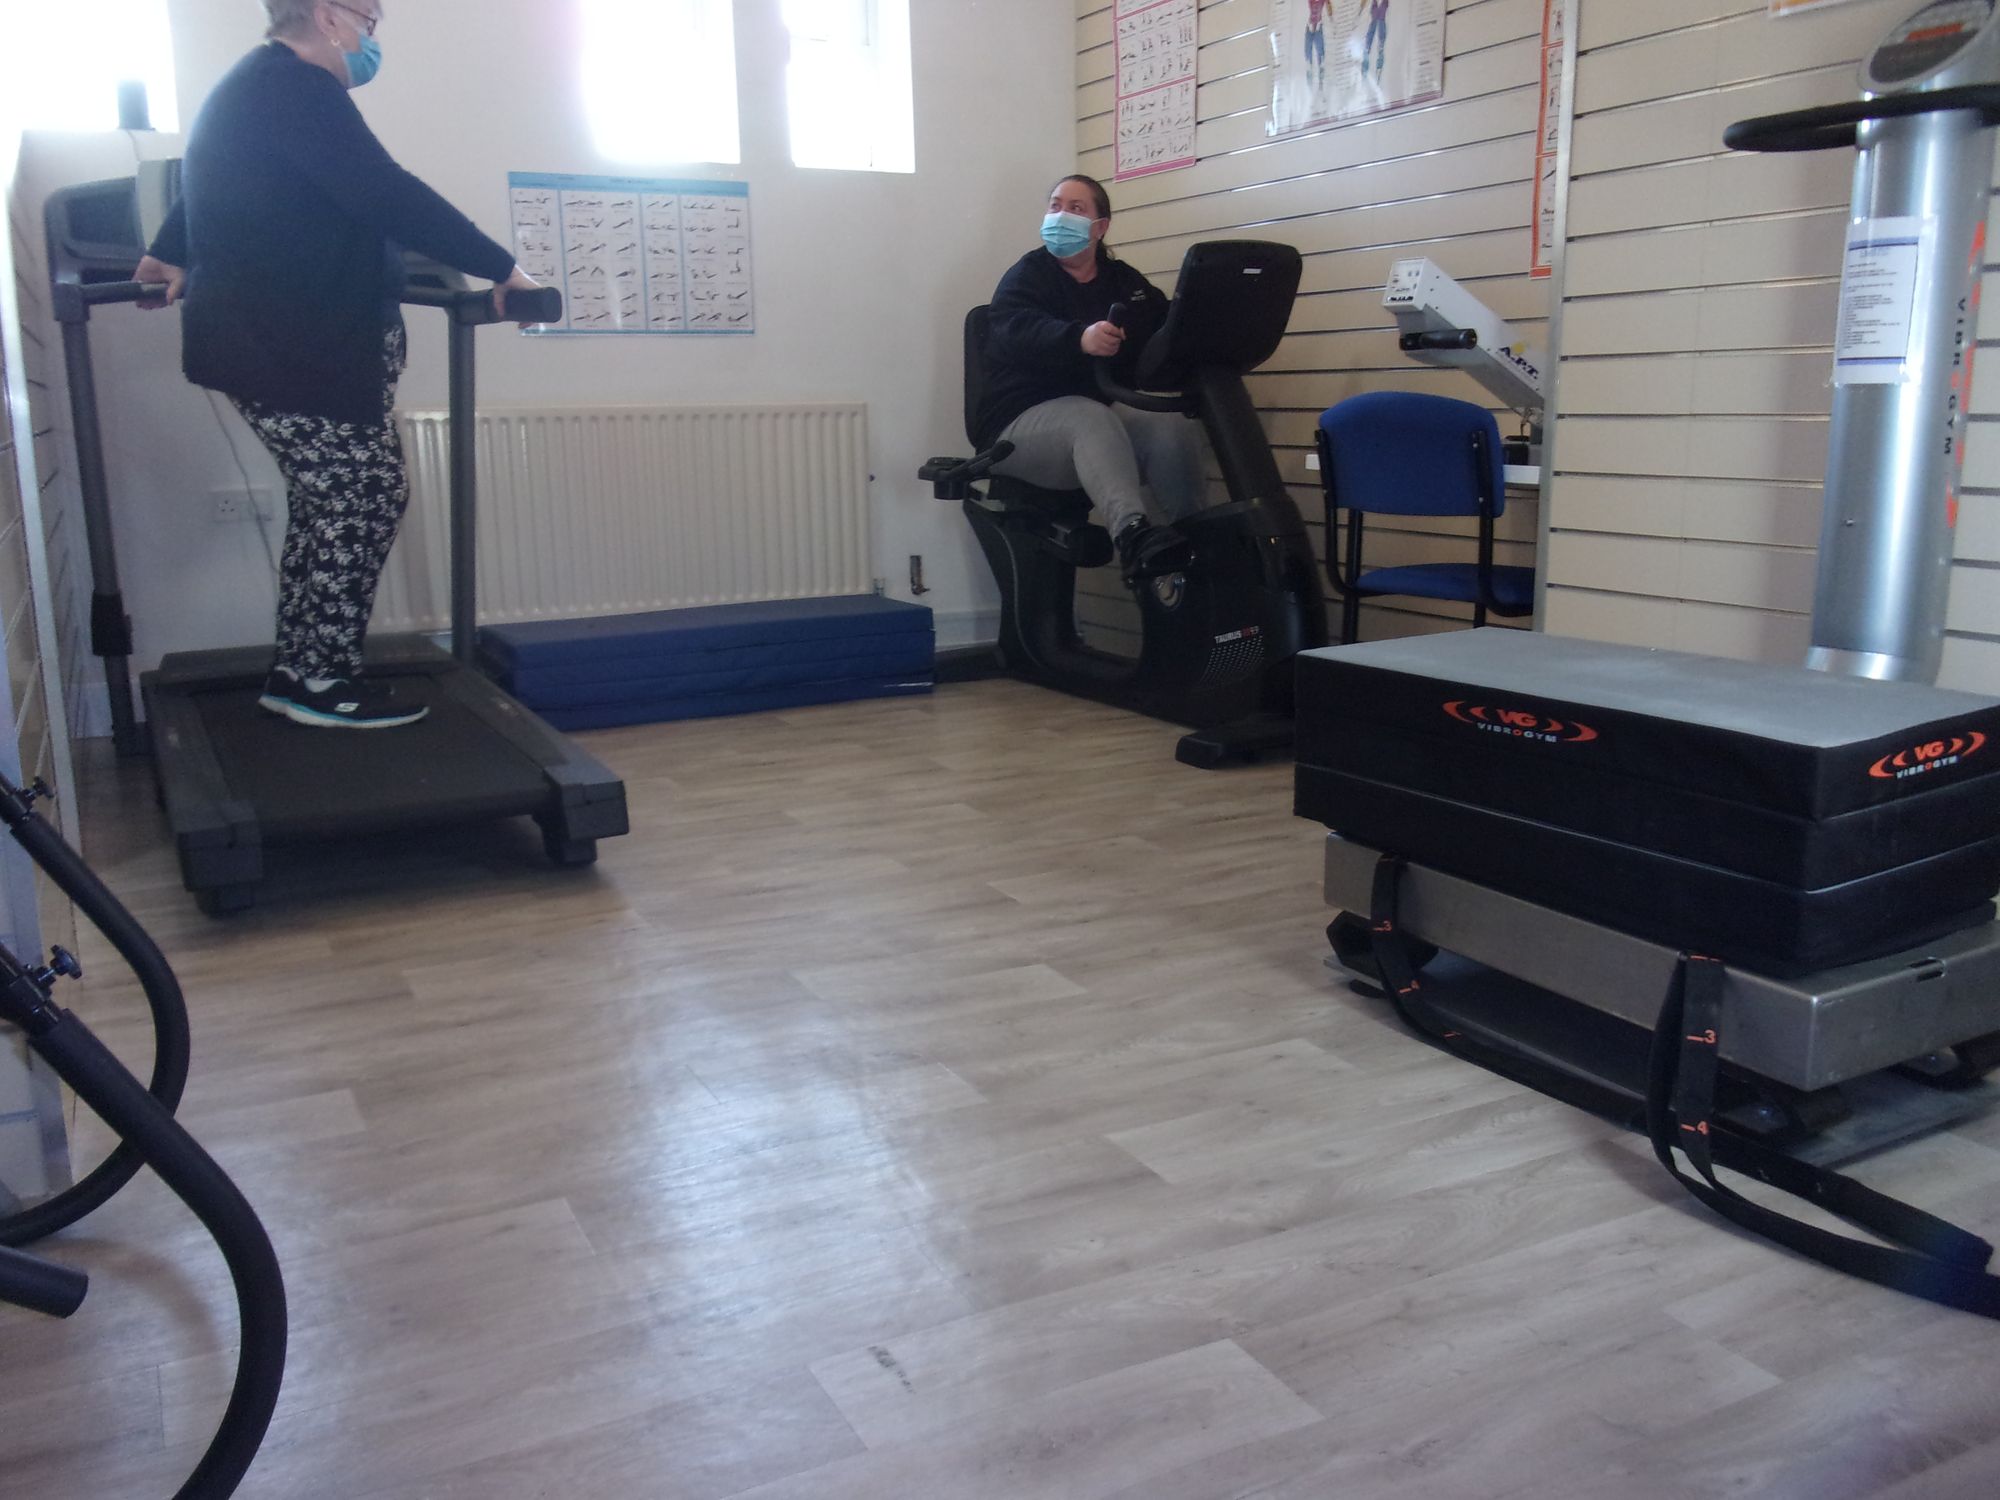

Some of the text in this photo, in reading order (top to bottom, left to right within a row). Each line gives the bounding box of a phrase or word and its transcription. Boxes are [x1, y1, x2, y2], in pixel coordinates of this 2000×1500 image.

[1495, 708, 1538, 728] VG
[1476, 722, 1557, 743] VIBROGYM
[1914, 740, 1945, 761] VG
[1896, 755, 1958, 779] VIBROGYM
[1704, 1029, 1717, 1044] 3
[1697, 1120, 1709, 1135] 4
